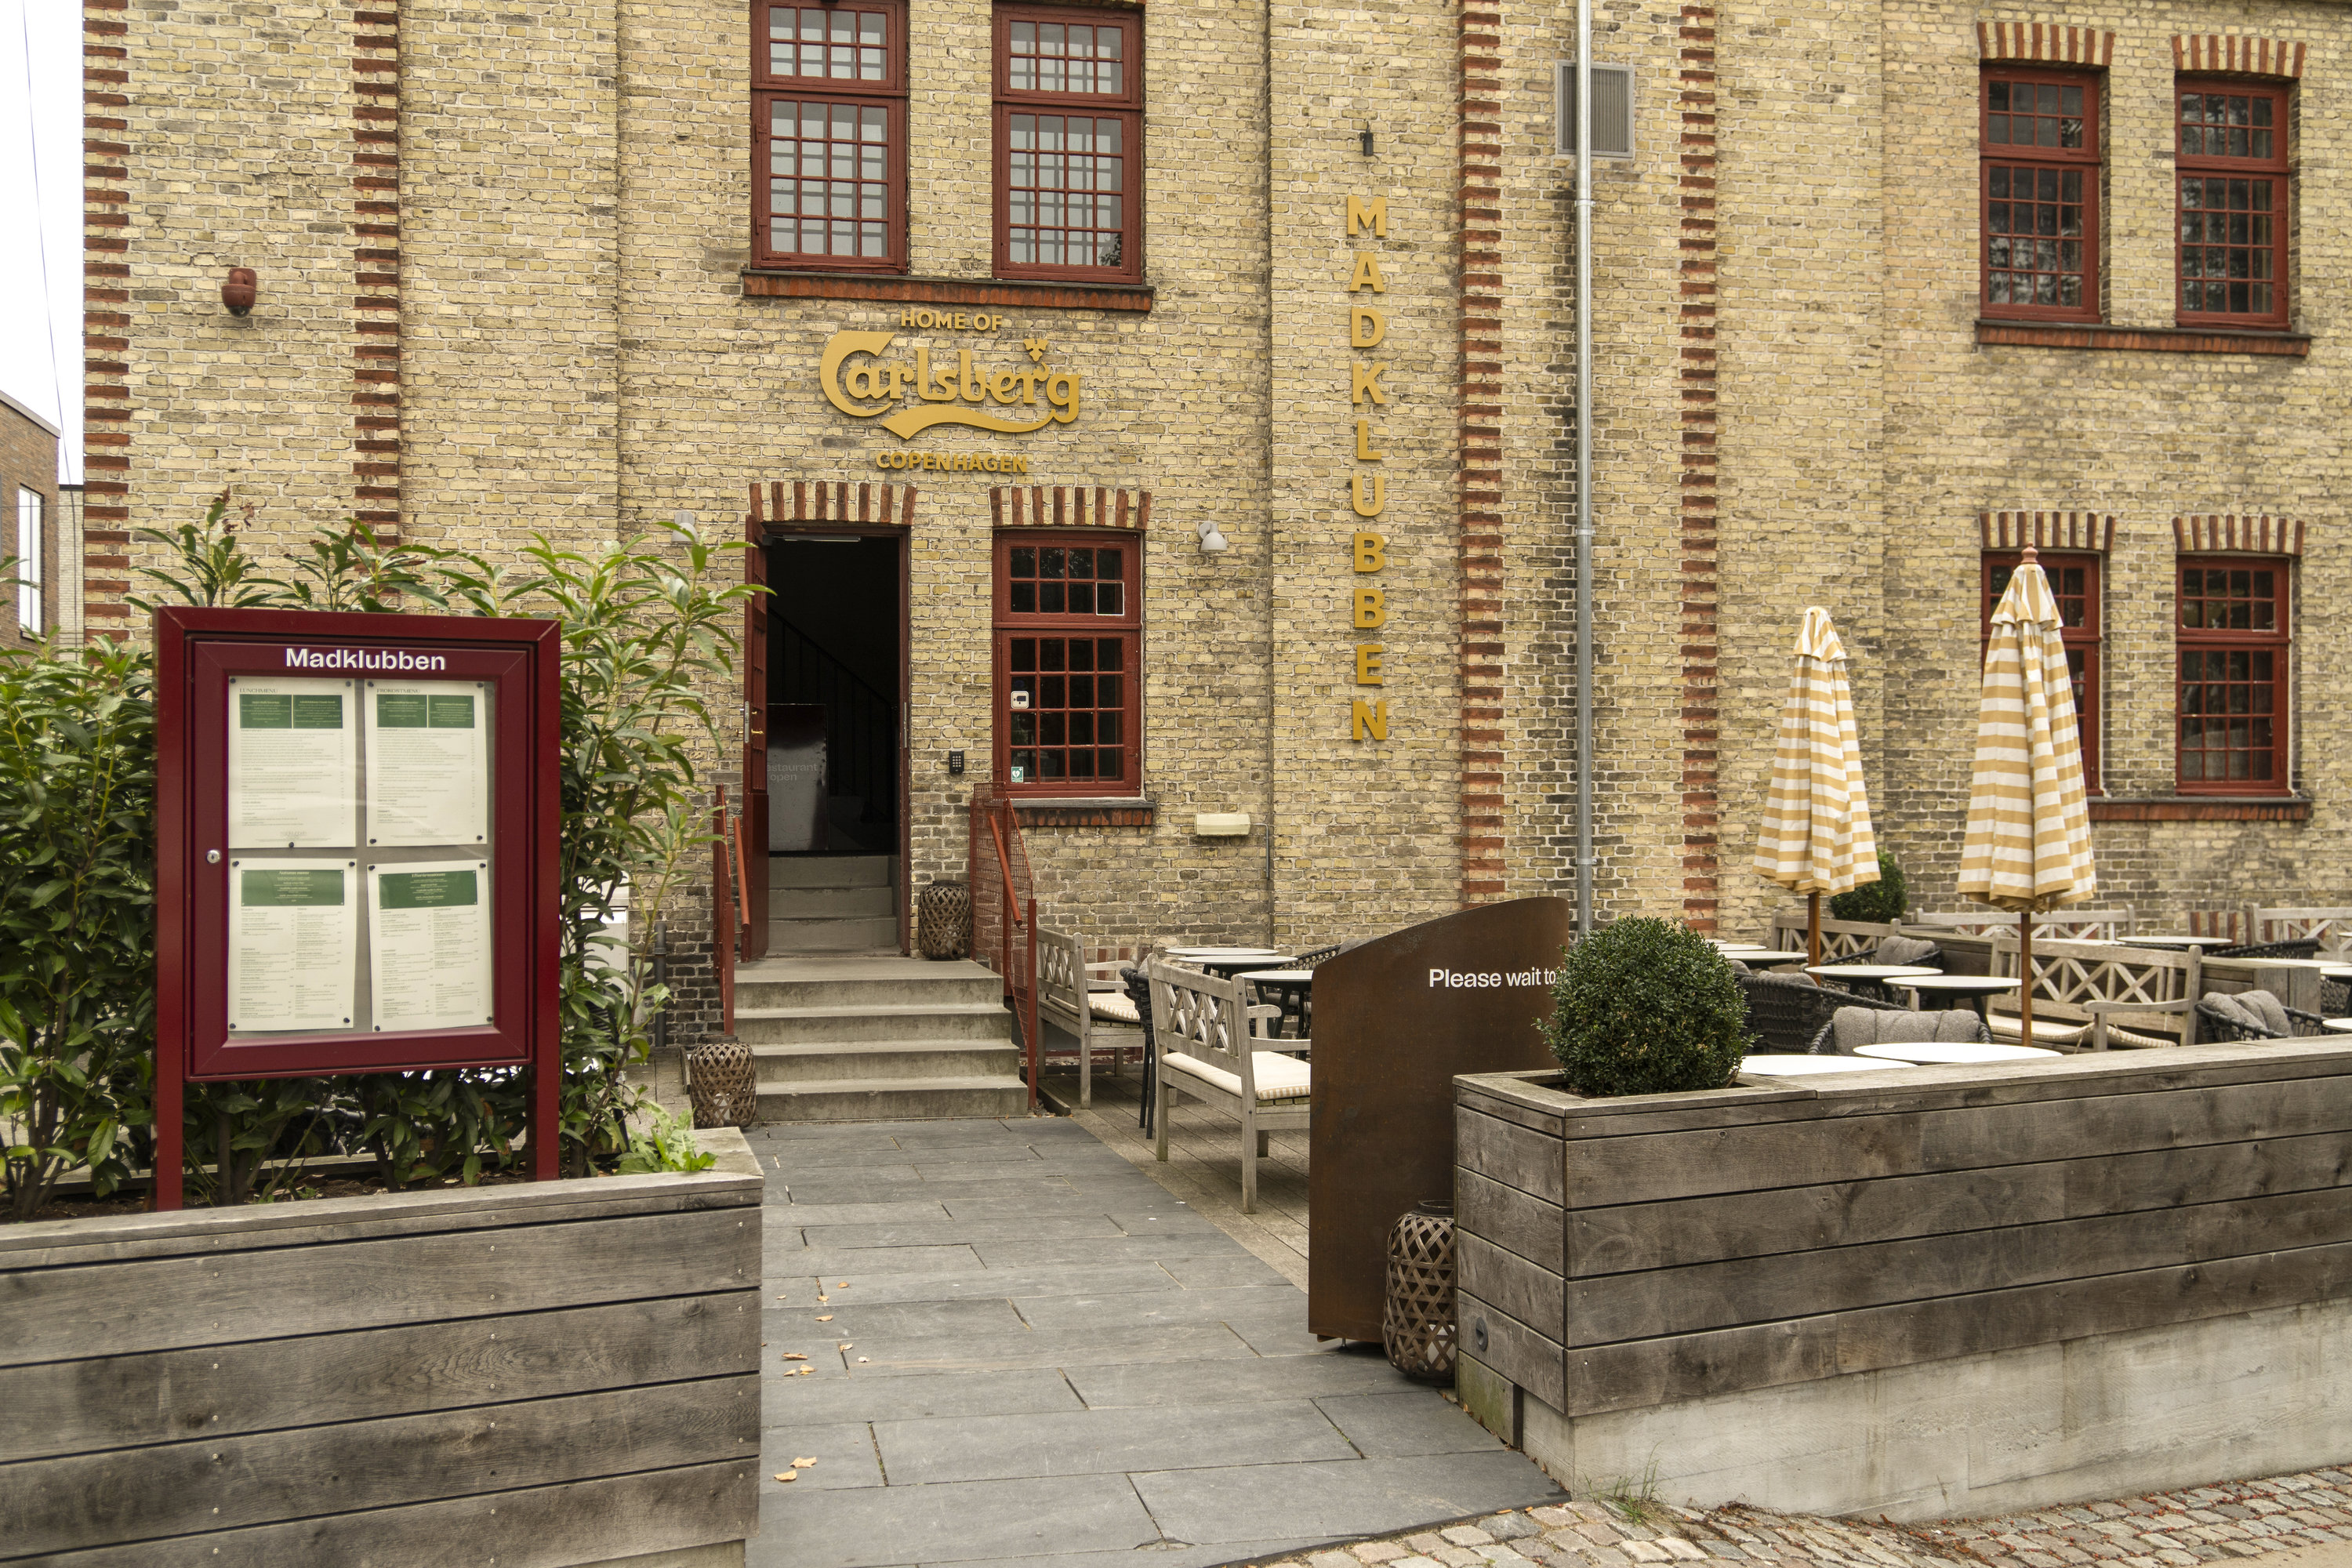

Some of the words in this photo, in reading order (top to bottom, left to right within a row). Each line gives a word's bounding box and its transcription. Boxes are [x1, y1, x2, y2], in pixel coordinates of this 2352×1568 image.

[900, 310, 966, 330] HOME
[973, 313, 1004, 332] OF
[819, 330, 1082, 439] Carlsberg
[876, 451, 1028, 474] COPENHAGEN
[1346, 194, 1388, 742] MADKLUBBEN
[285, 648, 446, 670] Madklubben
[770, 774, 797, 782] open
[1429, 968, 1502, 988] Please
[1505, 967, 1541, 987] wait
[1544, 967, 1556, 985] to
